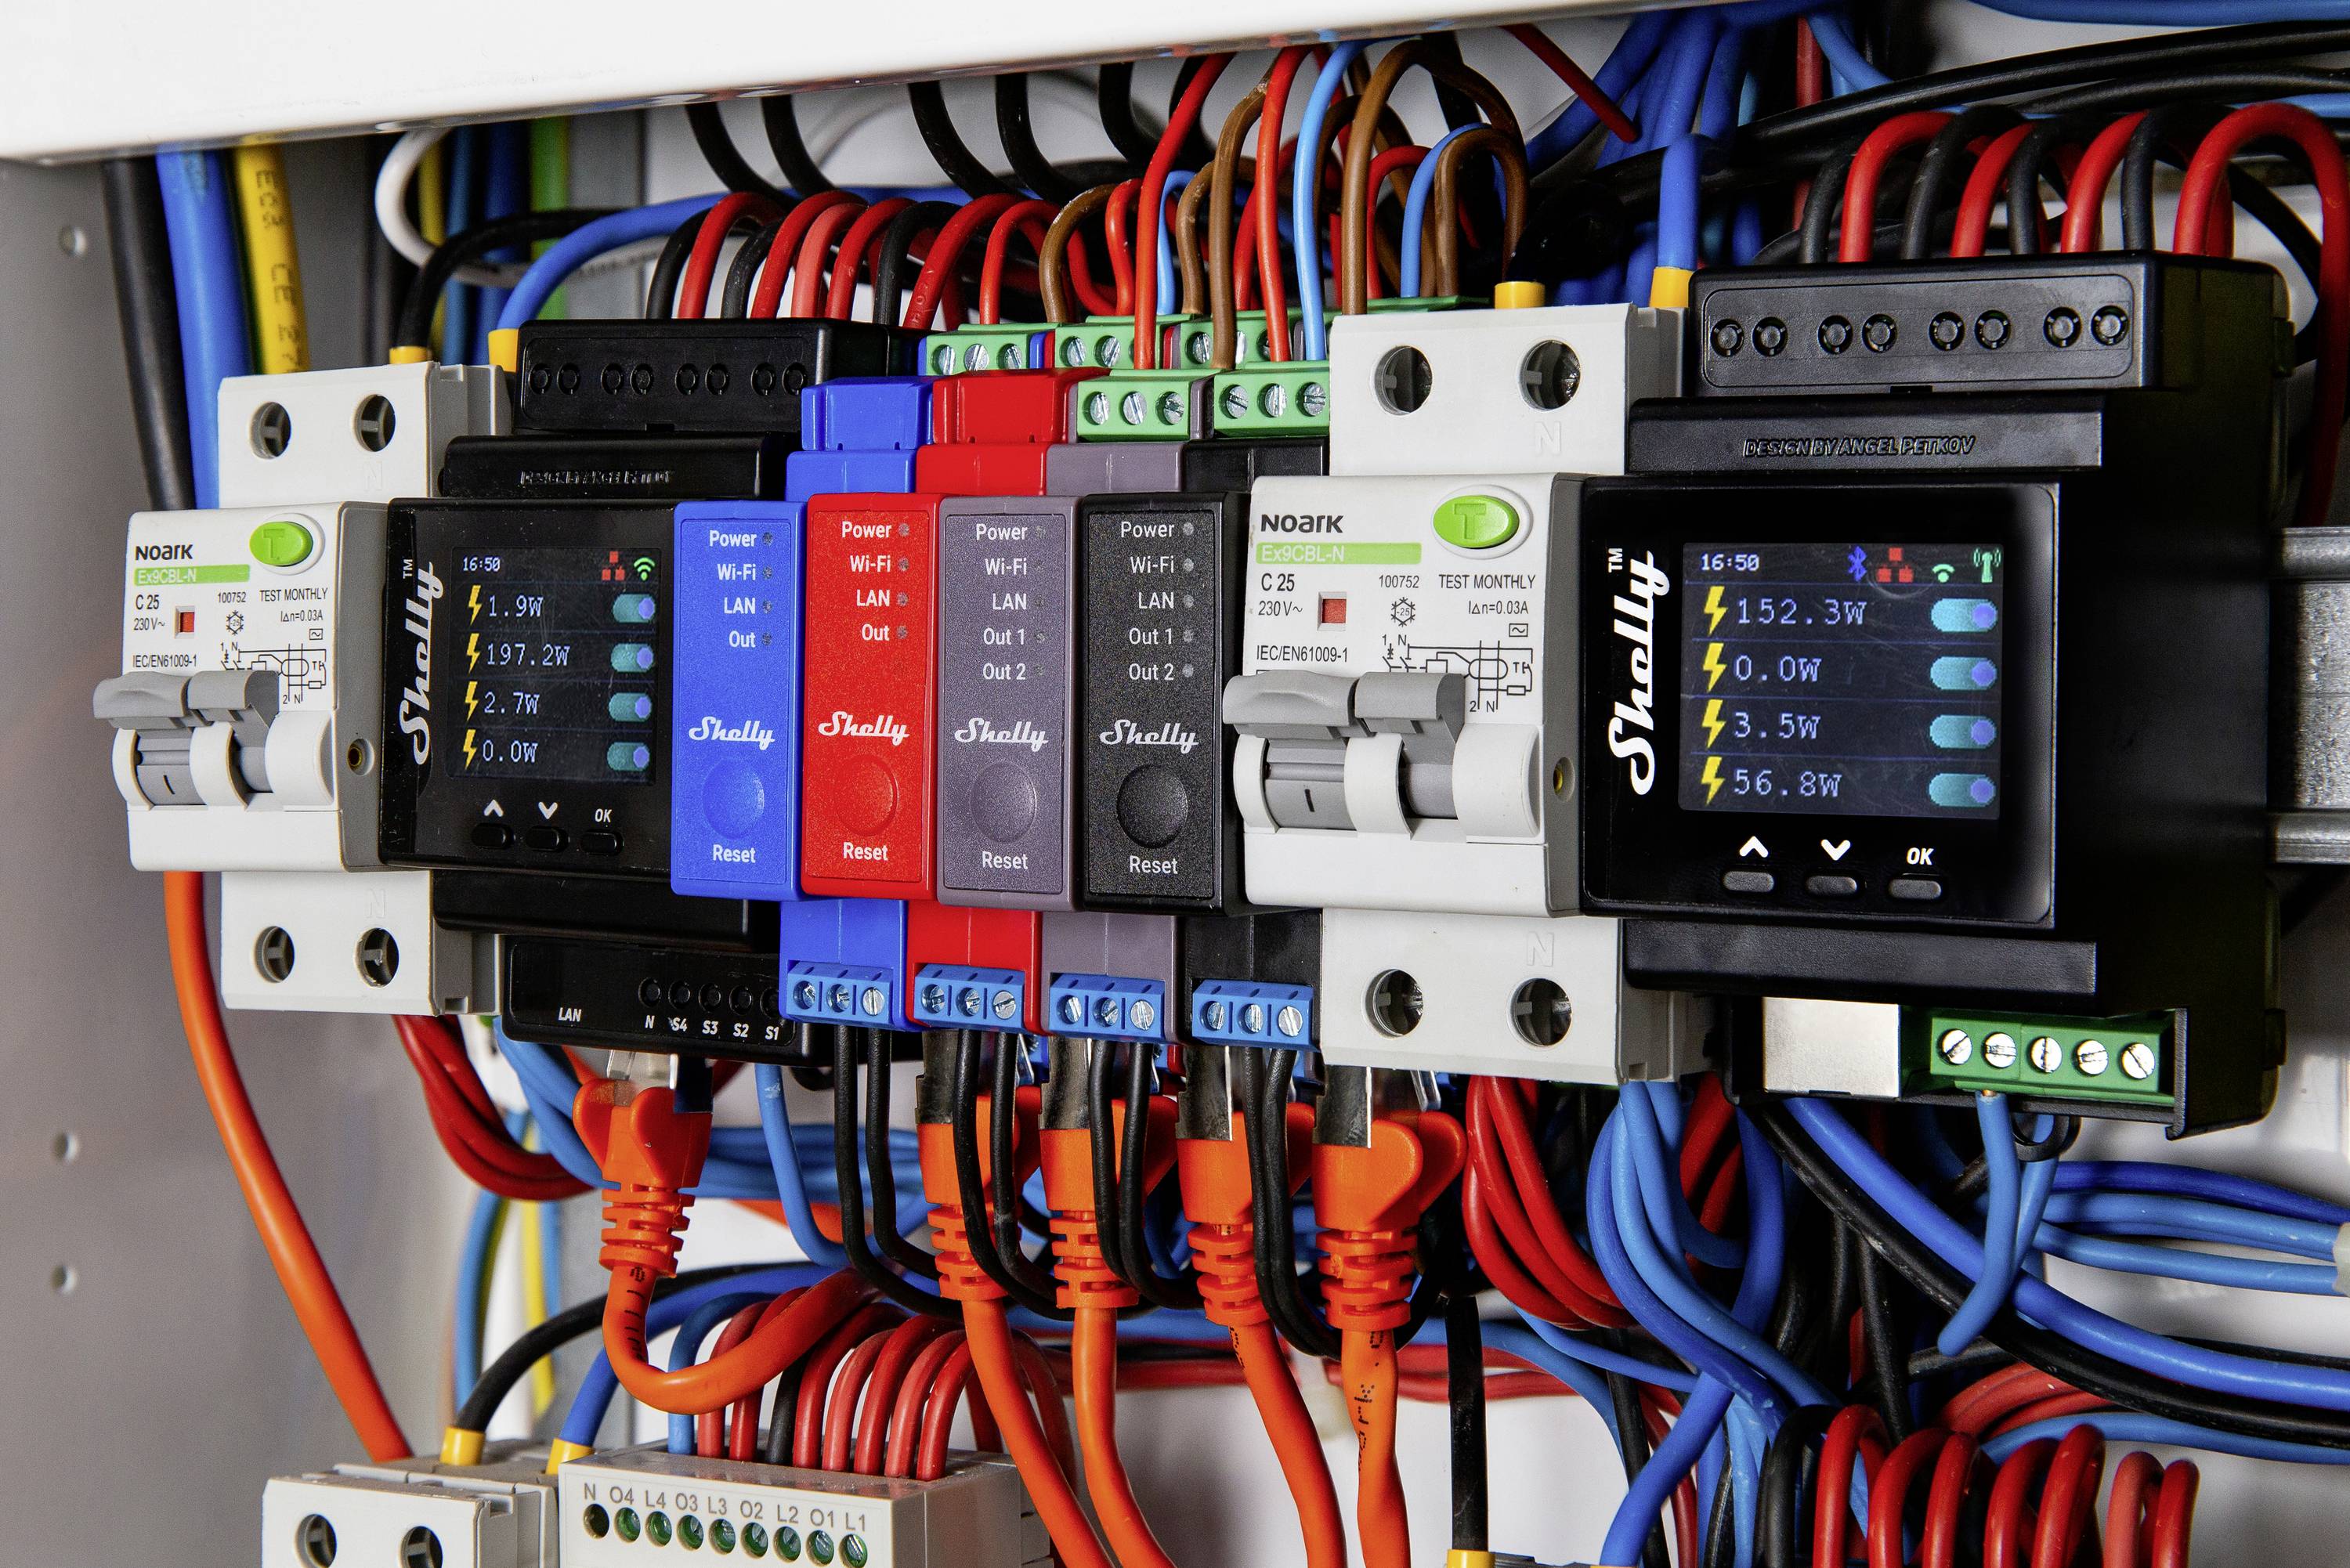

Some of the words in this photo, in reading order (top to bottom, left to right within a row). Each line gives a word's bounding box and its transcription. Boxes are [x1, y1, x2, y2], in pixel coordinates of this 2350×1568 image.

[1535, 421, 1561, 455] N
[1743, 438, 1810, 457] DESIGN
[1810, 437, 1840, 457] BY
[1838, 436, 1899, 456] ANGEL
[1900, 435, 1977, 455] PETKOV
[841, 521, 891, 538] Power
[1120, 521, 1174, 538] Power
[1455, 504, 1487, 539] T
[709, 530, 757, 547] Power
[976, 523, 1028, 540] Power
[263, 529, 284, 558] T
[1261, 545, 1344, 563] Ex9CBL-N
[1607, 548, 1623, 572] TM
[1701, 553, 1759, 571] 16:50
[403, 558, 413, 579] TM
[463, 557, 501, 572] 16:50
[717, 563, 756, 580] Wi-Fi
[850, 555, 891, 573] Wi-Fi
[985, 558, 1027, 576] Wi-Fi
[1130, 556, 1174, 573] Wi-Fi
[138, 569, 196, 584] Ex9CBL-N
[1261, 573, 1272, 591] C
[1277, 573, 1295, 591] 25
[1379, 575, 1419, 588] 100752
[1439, 574, 1470, 588] TEST
[1474, 574, 1535, 588] MONTHLY
[136, 594, 143, 610] C
[146, 594, 160, 609] 25
[218, 592, 247, 603] 100752
[259, 589, 281, 602] TEST
[284, 587, 328, 601] MONTHLY
[857, 590, 890, 607] LAN
[992, 593, 1027, 610] LAN
[1138, 591, 1174, 609] LAN
[489, 595, 544, 617] 1.9W
[724, 598, 756, 614] LAN
[1737, 598, 1867, 625] 152.3W
[728, 630, 756, 648] Out
[862, 623, 890, 641] Out
[983, 627, 1011, 645] Out
[1018, 628, 1025, 645] 1
[1129, 628, 1158, 645] Out
[1165, 628, 1173, 645] 1
[1398, 634, 1407, 646] N
[132, 655, 197, 667] IEC/EN61009-1
[400, 562, 443, 764] Shelly
[486, 643, 571, 666] 197.2W
[1256, 645, 1348, 663] IEC/EN61009-1
[982, 663, 1012, 681] Out
[1016, 663, 1026, 680] 2
[1129, 663, 1159, 681] Out
[1164, 663, 1174, 681] 2
[1608, 551, 1669, 795] Shelly
[1735, 655, 1821, 682] 0.0W
[484, 692, 540, 714] 2.7W
[1470, 701, 1477, 712] 2
[1487, 701, 1495, 712] N
[689, 716, 775, 750] Shelly
[818, 710, 909, 746] Shelly
[954, 717, 1048, 752] Shelly
[1734, 712, 1820, 739] 3.5W
[1100, 719, 1199, 753] Shelly
[483, 740, 538, 763] 0.0W
[1734, 770, 1842, 797] 56.8W
[595, 808, 612, 823] OK
[713, 844, 756, 863] Reset
[843, 842, 888, 861] Reset
[982, 851, 1028, 870] Reset
[1907, 848, 1934, 865] OK
[1130, 855, 1178, 874] Reset
[1527, 932, 1554, 967] N
[558, 1007, 582, 1022] LAN
[645, 1015, 655, 1029] N
[671, 1017, 688, 1032] S4
[702, 1021, 719, 1035] S3
[733, 1023, 750, 1038] S2
[765, 1025, 779, 1040] S1
[584, 1483, 595, 1500] N
[645, 1490, 666, 1508] L4
[708, 1496, 728, 1516] L3
[777, 1504, 799, 1523] L2
[846, 1512, 866, 1531] L1
